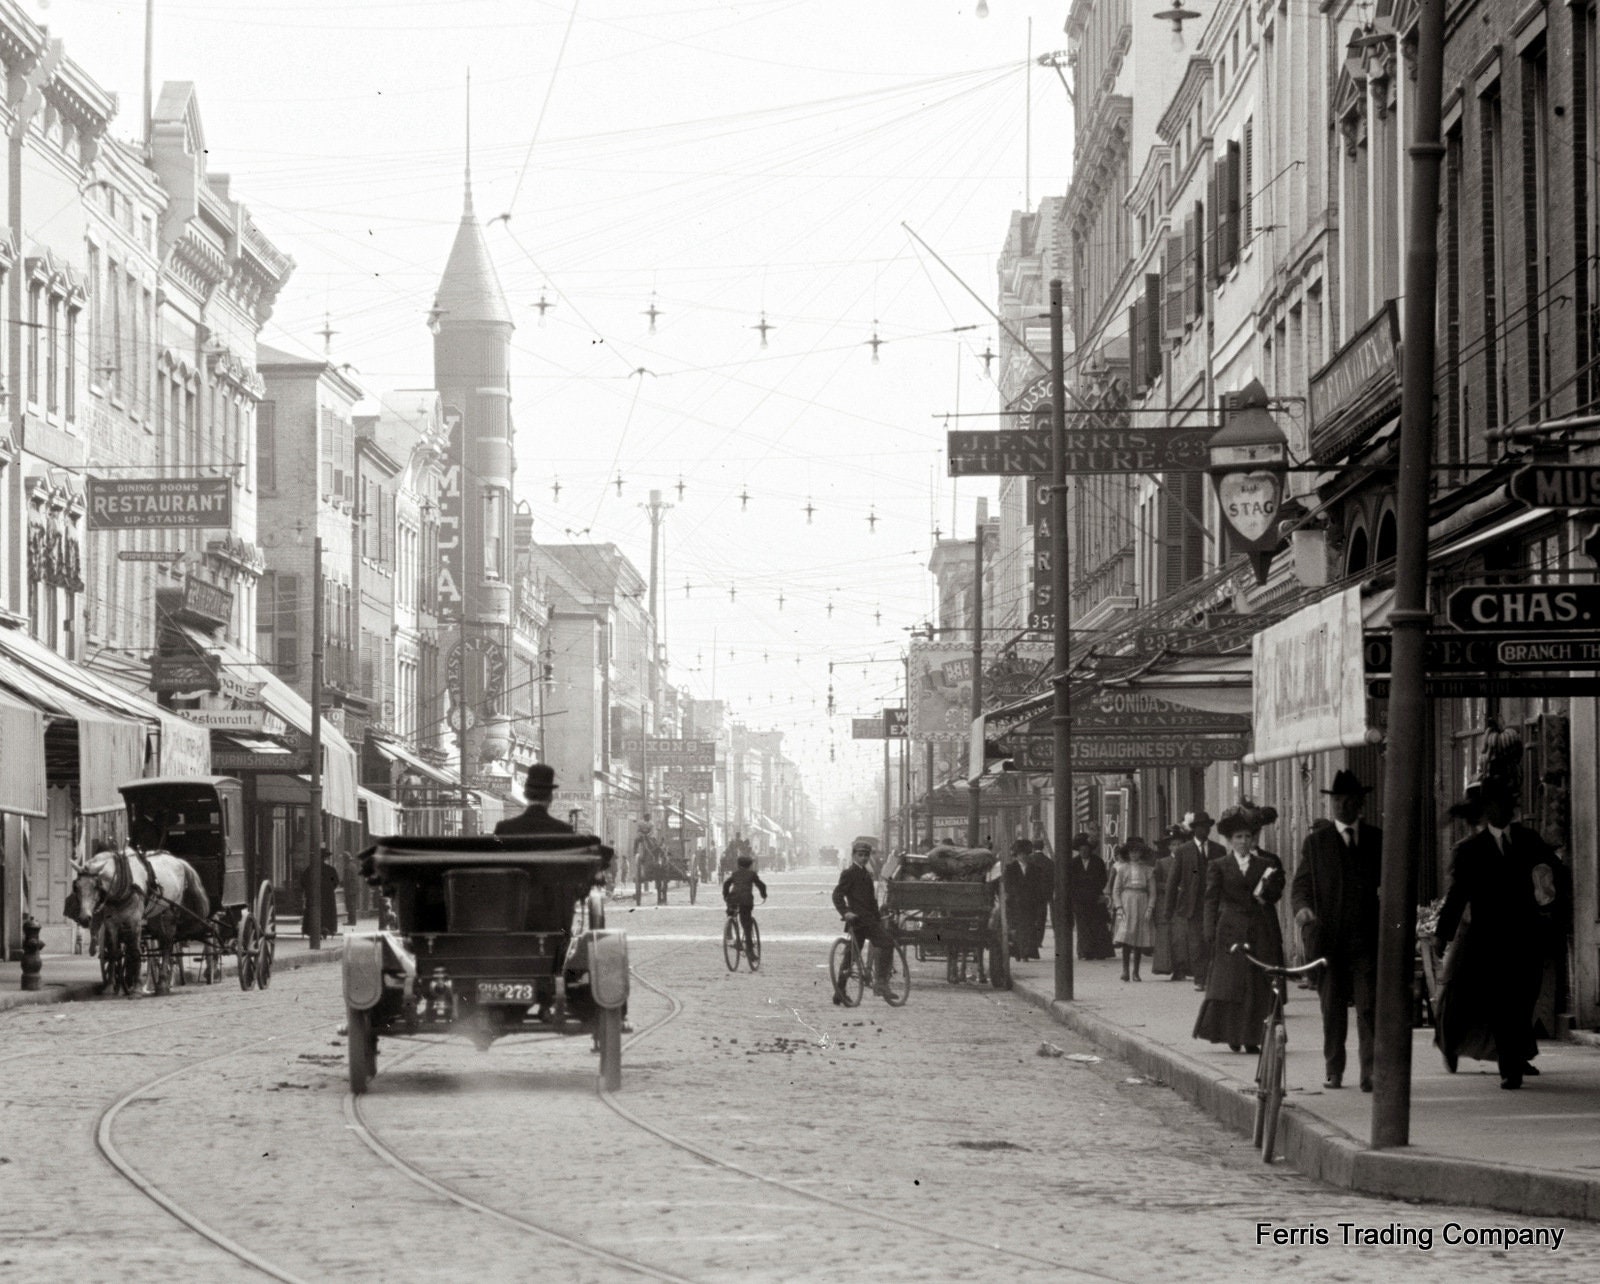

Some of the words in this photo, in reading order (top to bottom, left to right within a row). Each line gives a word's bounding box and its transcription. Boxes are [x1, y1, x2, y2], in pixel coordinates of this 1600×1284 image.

[957, 450, 1163, 471] FURNTURE.
[117, 483, 154, 492] DINING
[160, 483, 199, 492] ROOMS
[94, 494, 226, 516] RESTAURANT
[1228, 500, 1274, 517] STAG
[1471, 592, 1591, 624] CHAS.
[1504, 644, 1572, 661] BRANCH
[214, 754, 287, 767] FURNISHINGS
[504, 983, 532, 1000] 273
